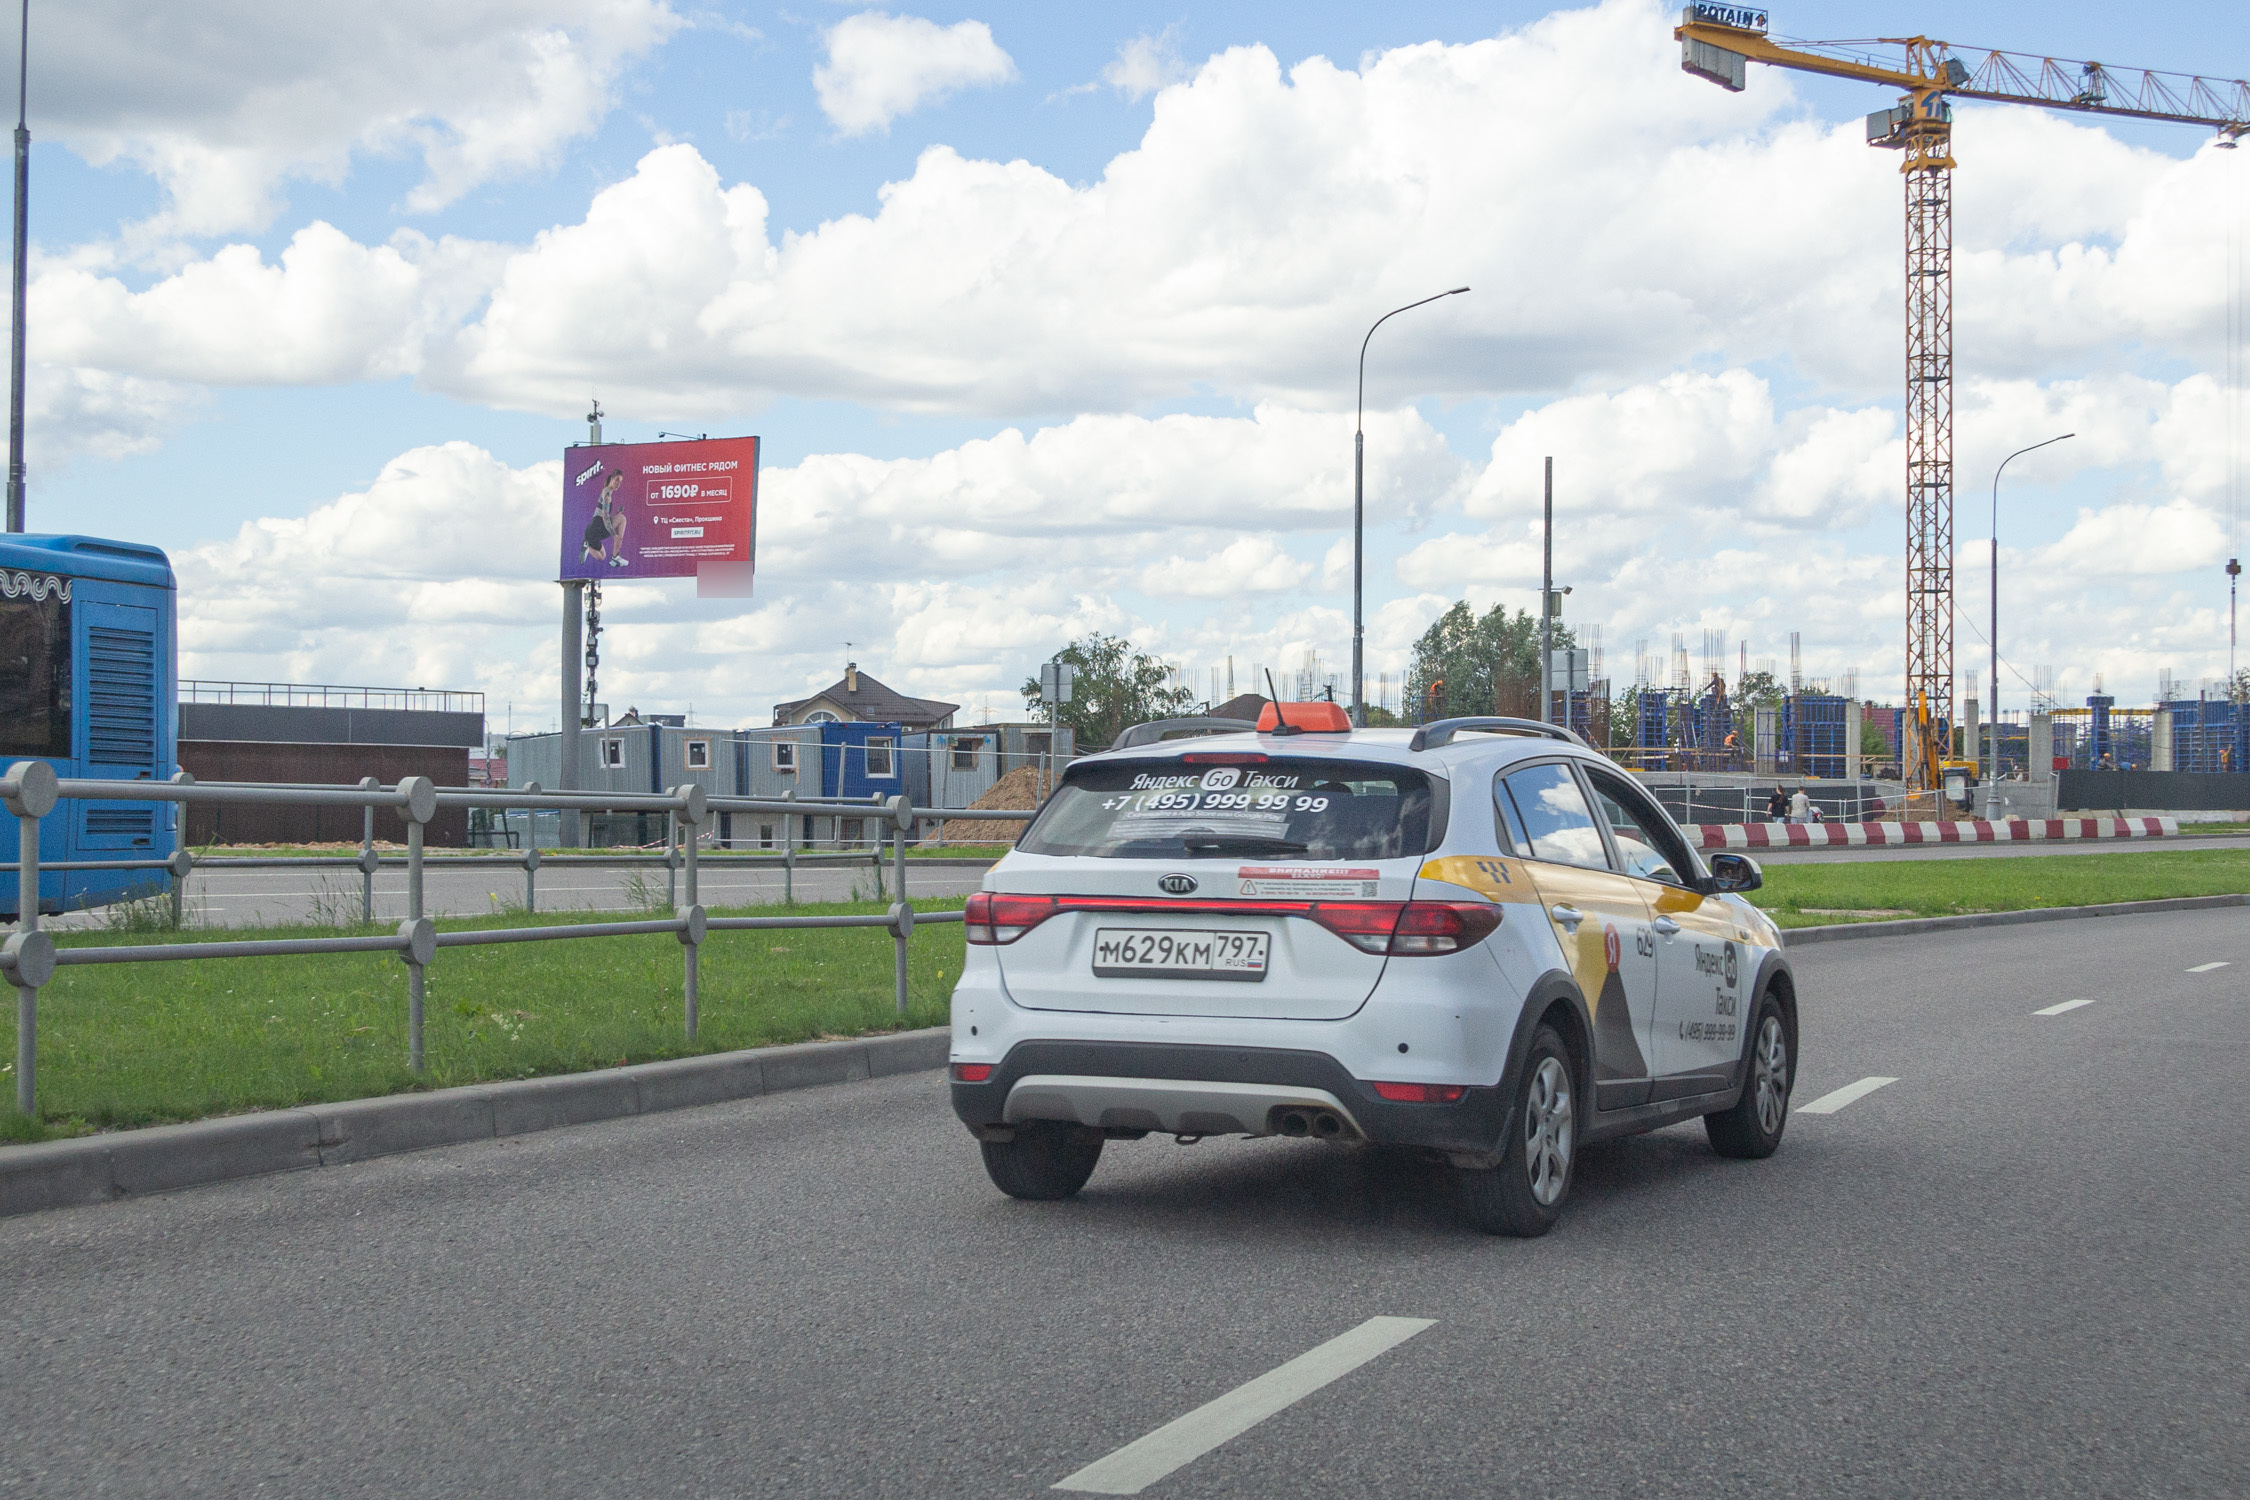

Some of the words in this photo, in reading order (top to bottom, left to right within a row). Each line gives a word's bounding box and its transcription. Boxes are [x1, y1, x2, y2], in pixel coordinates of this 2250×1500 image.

[1697, 4, 1753, 26] POTAIN
[642, 462, 672, 474] НОВЫЙ
[673, 462, 707, 473] ФИТНЕС
[708, 460, 738, 471] РЯДОМ
[660, 484, 699, 499] 1690₽
[1128, 773, 1199, 790] Яндекс
[1205, 770, 1234, 788] Go
[1243, 770, 1299, 788] Такси
[1101, 795, 1131, 811] +7
[1134, 793, 1200, 812] (495)
[1202, 794, 1251, 810] 999
[1255, 794, 1289, 811] 99
[1295, 796, 1329, 813] 99
[1163, 878, 1191, 892] KIA
[1102, 935, 1212, 966] М629КМ
[1217, 936, 1259, 959] 797
[1608, 932, 1617, 964] Я
[1636, 927, 1653, 957] 629
[1225, 958, 1247, 967] RUS
[1695, 943, 1724, 978] Яндекс
[1725, 948, 1737, 980] Go
[1716, 987, 1736, 1017] Такси
